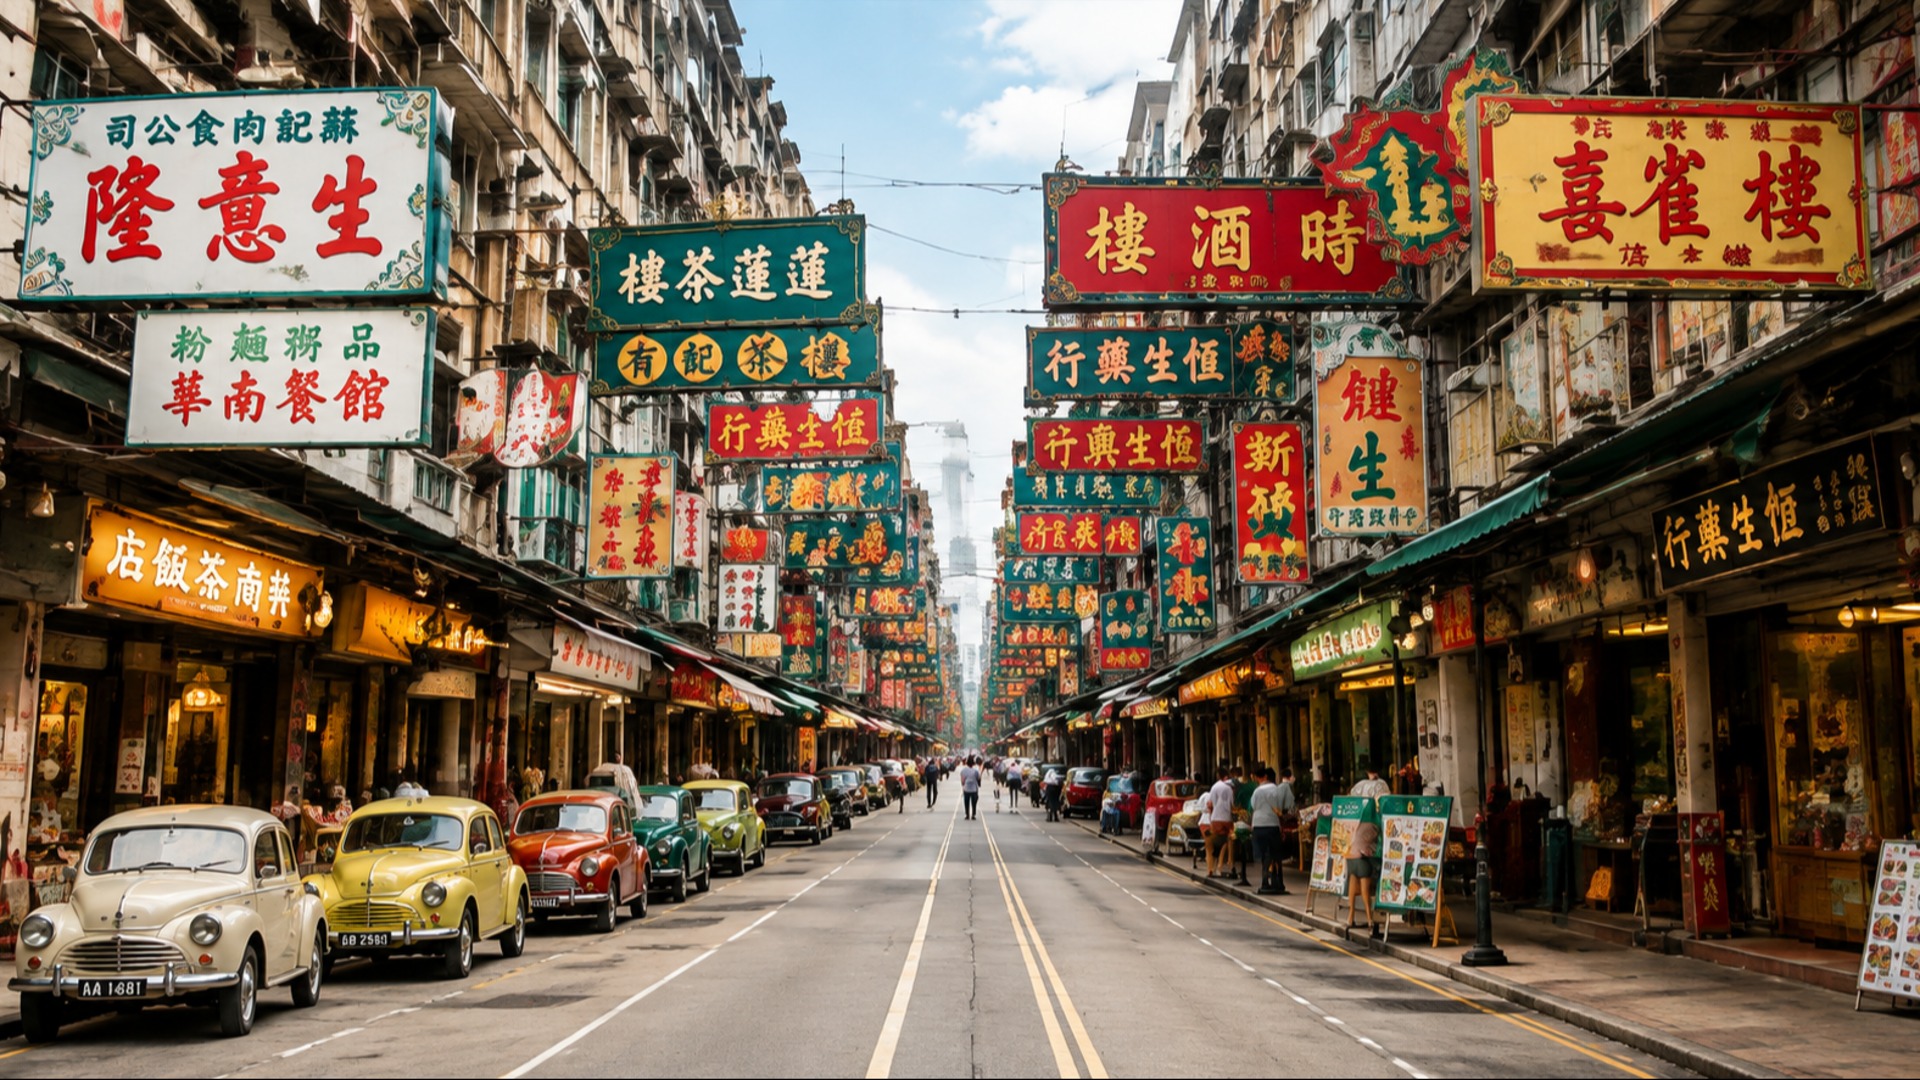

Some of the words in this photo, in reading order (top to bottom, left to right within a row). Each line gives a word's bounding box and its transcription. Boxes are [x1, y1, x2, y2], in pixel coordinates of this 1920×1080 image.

[162, 368, 390, 427] 華南餐館
[83, 982, 102, 996] AA
